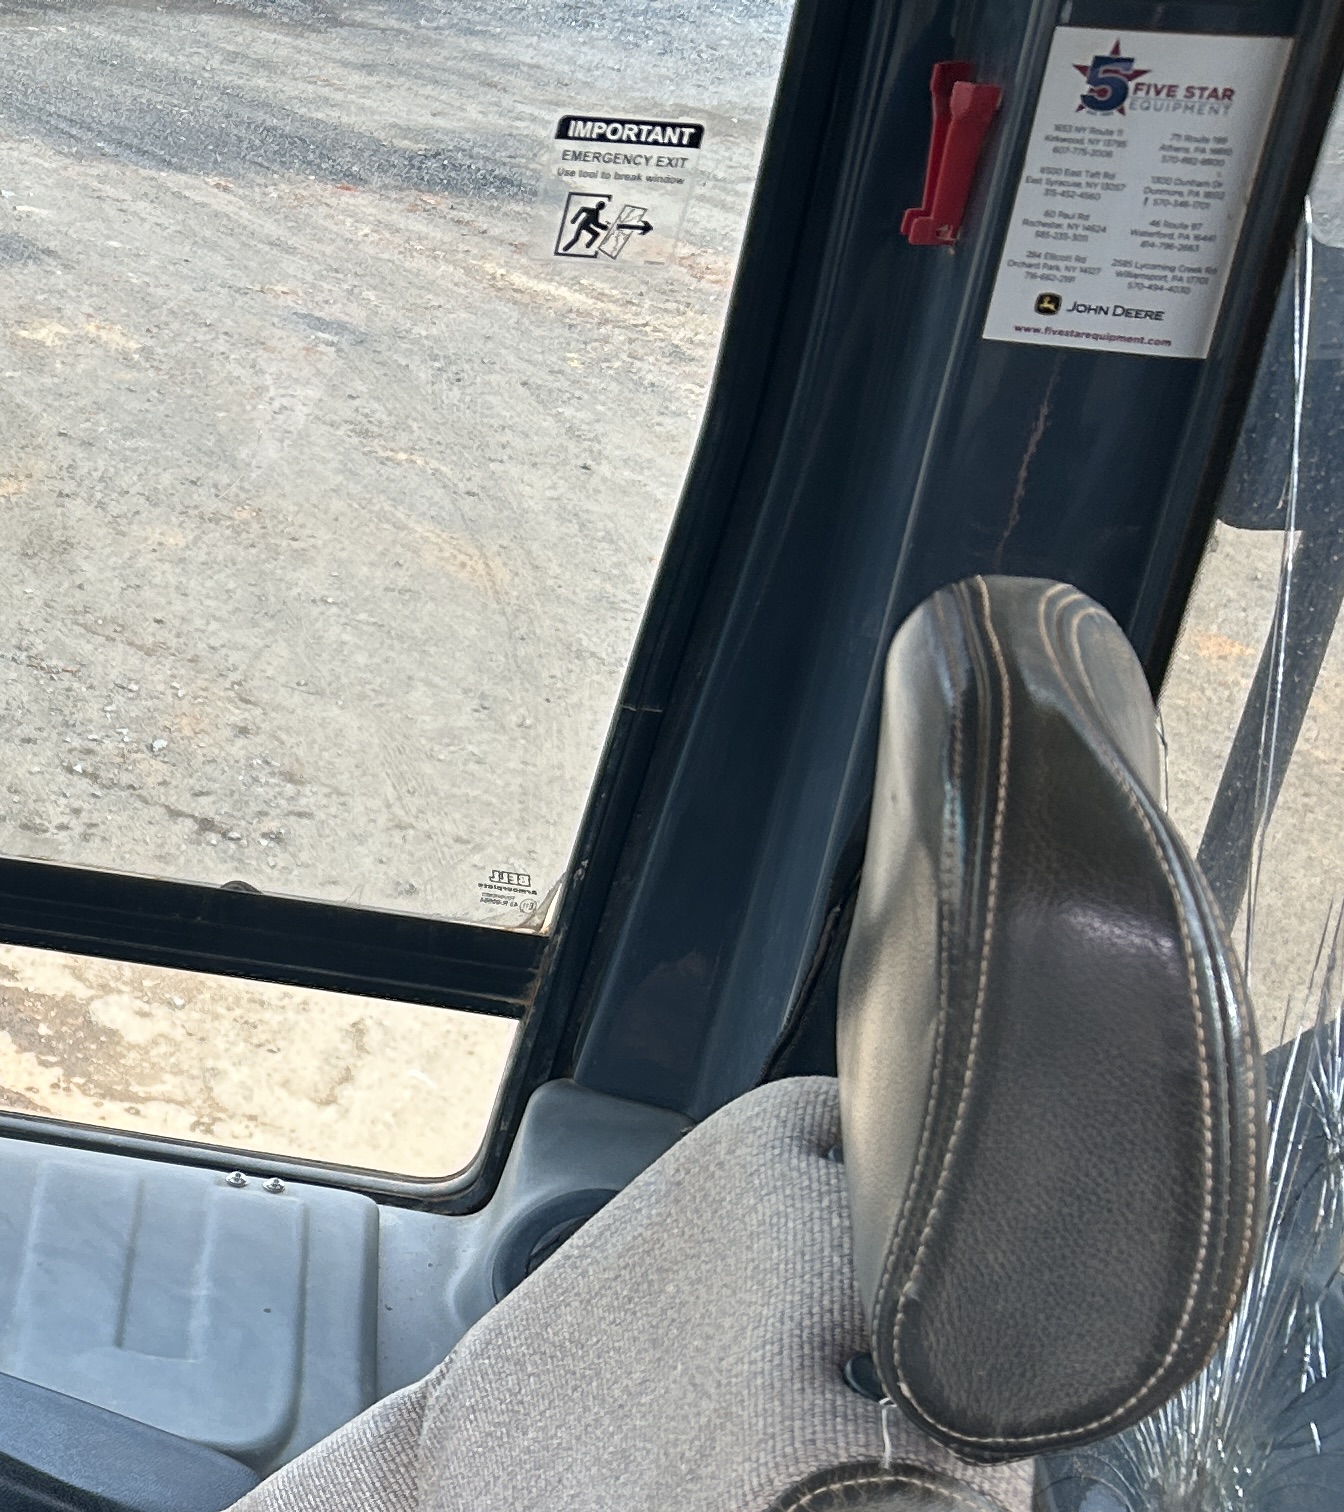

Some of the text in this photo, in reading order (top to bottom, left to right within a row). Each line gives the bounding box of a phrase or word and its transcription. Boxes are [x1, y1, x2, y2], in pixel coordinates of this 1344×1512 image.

[1133, 83, 1234, 101] FIVE STAR
[1128, 100, 1232, 116] EQUIPMENT
[567, 120, 695, 145] IMPORTANT
[562, 150, 689, 168] EMERGENCY EXIT
[557, 168, 684, 185] Use tool to break window
[1067, 301, 1165, 321] JOHN DEERE
[1014, 324, 1171, 347] www.fivestarequipment.com
